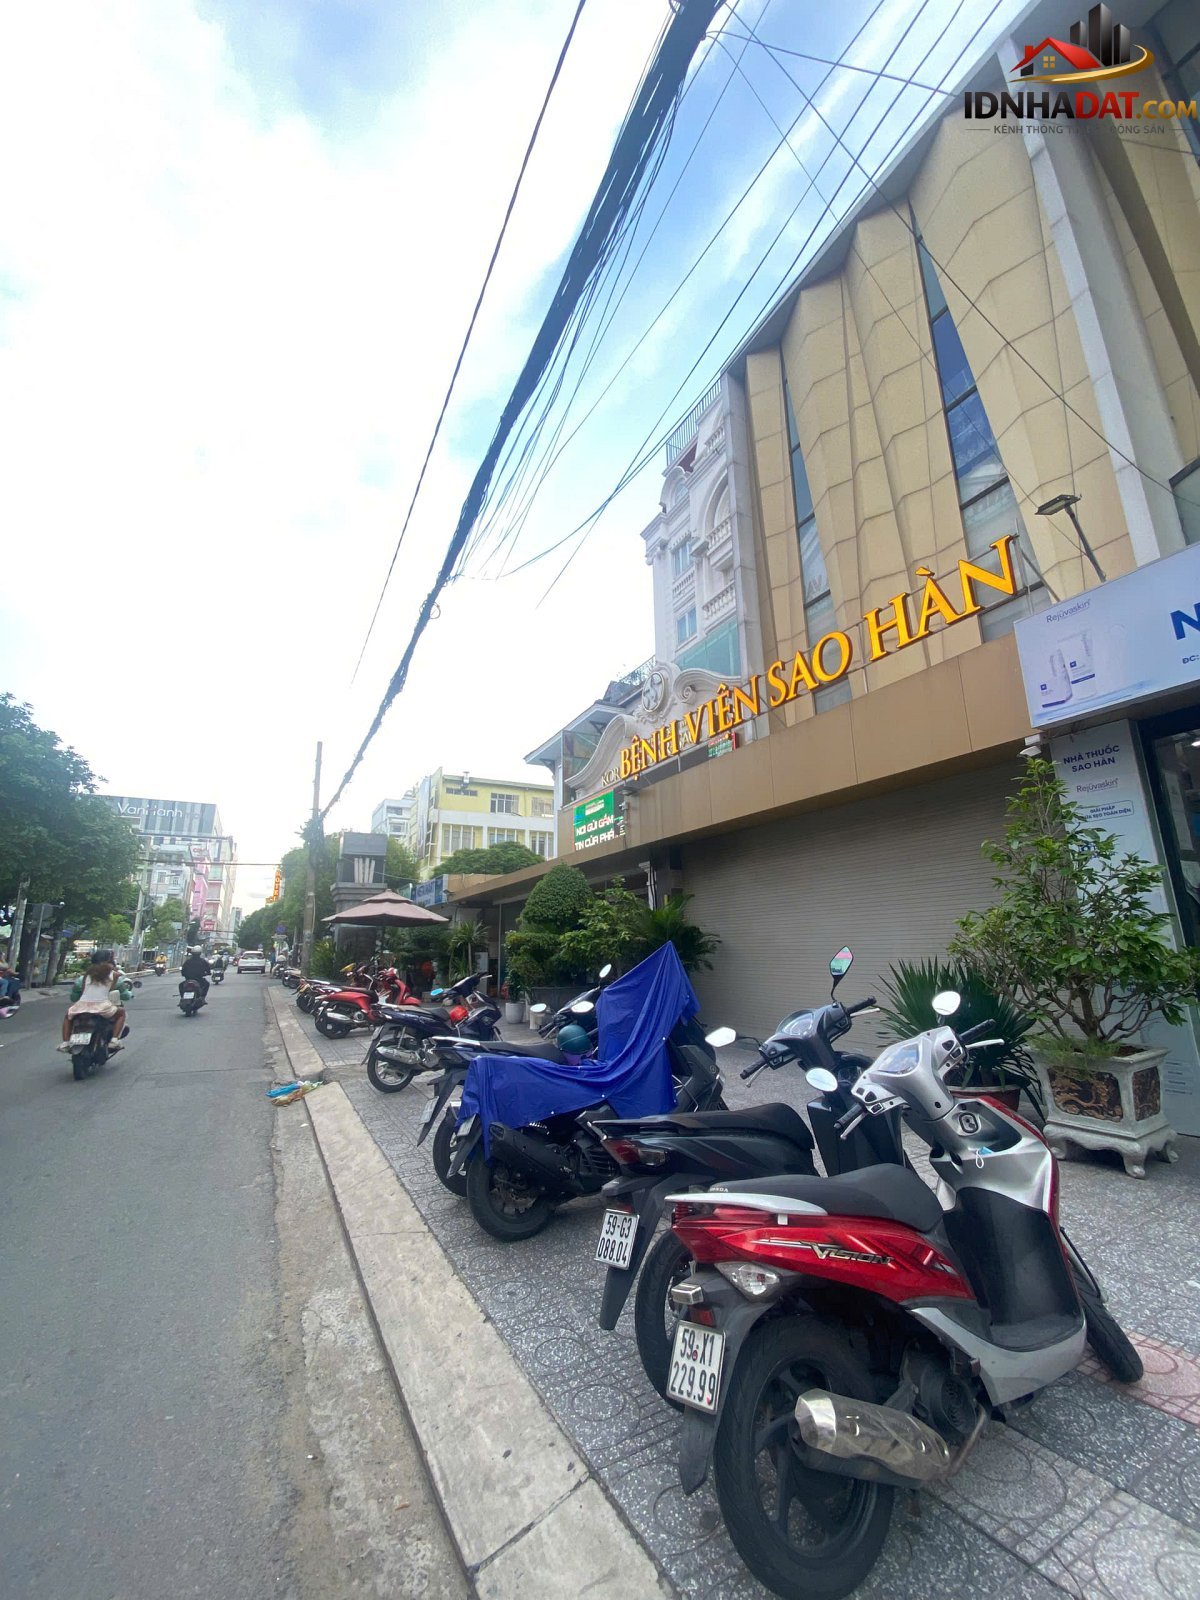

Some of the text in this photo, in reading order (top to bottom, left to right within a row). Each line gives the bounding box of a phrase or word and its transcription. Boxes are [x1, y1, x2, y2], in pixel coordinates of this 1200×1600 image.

[619, 534, 1018, 780] BỆNH VIỆN SAO HÀN
[1063, 744, 1120, 765] NHÀ THUỐC
[1072, 756, 1116, 773] SAO HÀN
[605, 1215, 632, 1238] 59-G3
[598, 1237, 628, 1264] 088.04
[811, 1243, 894, 1265] VISION
[671, 1361, 716, 1405] 229.99
